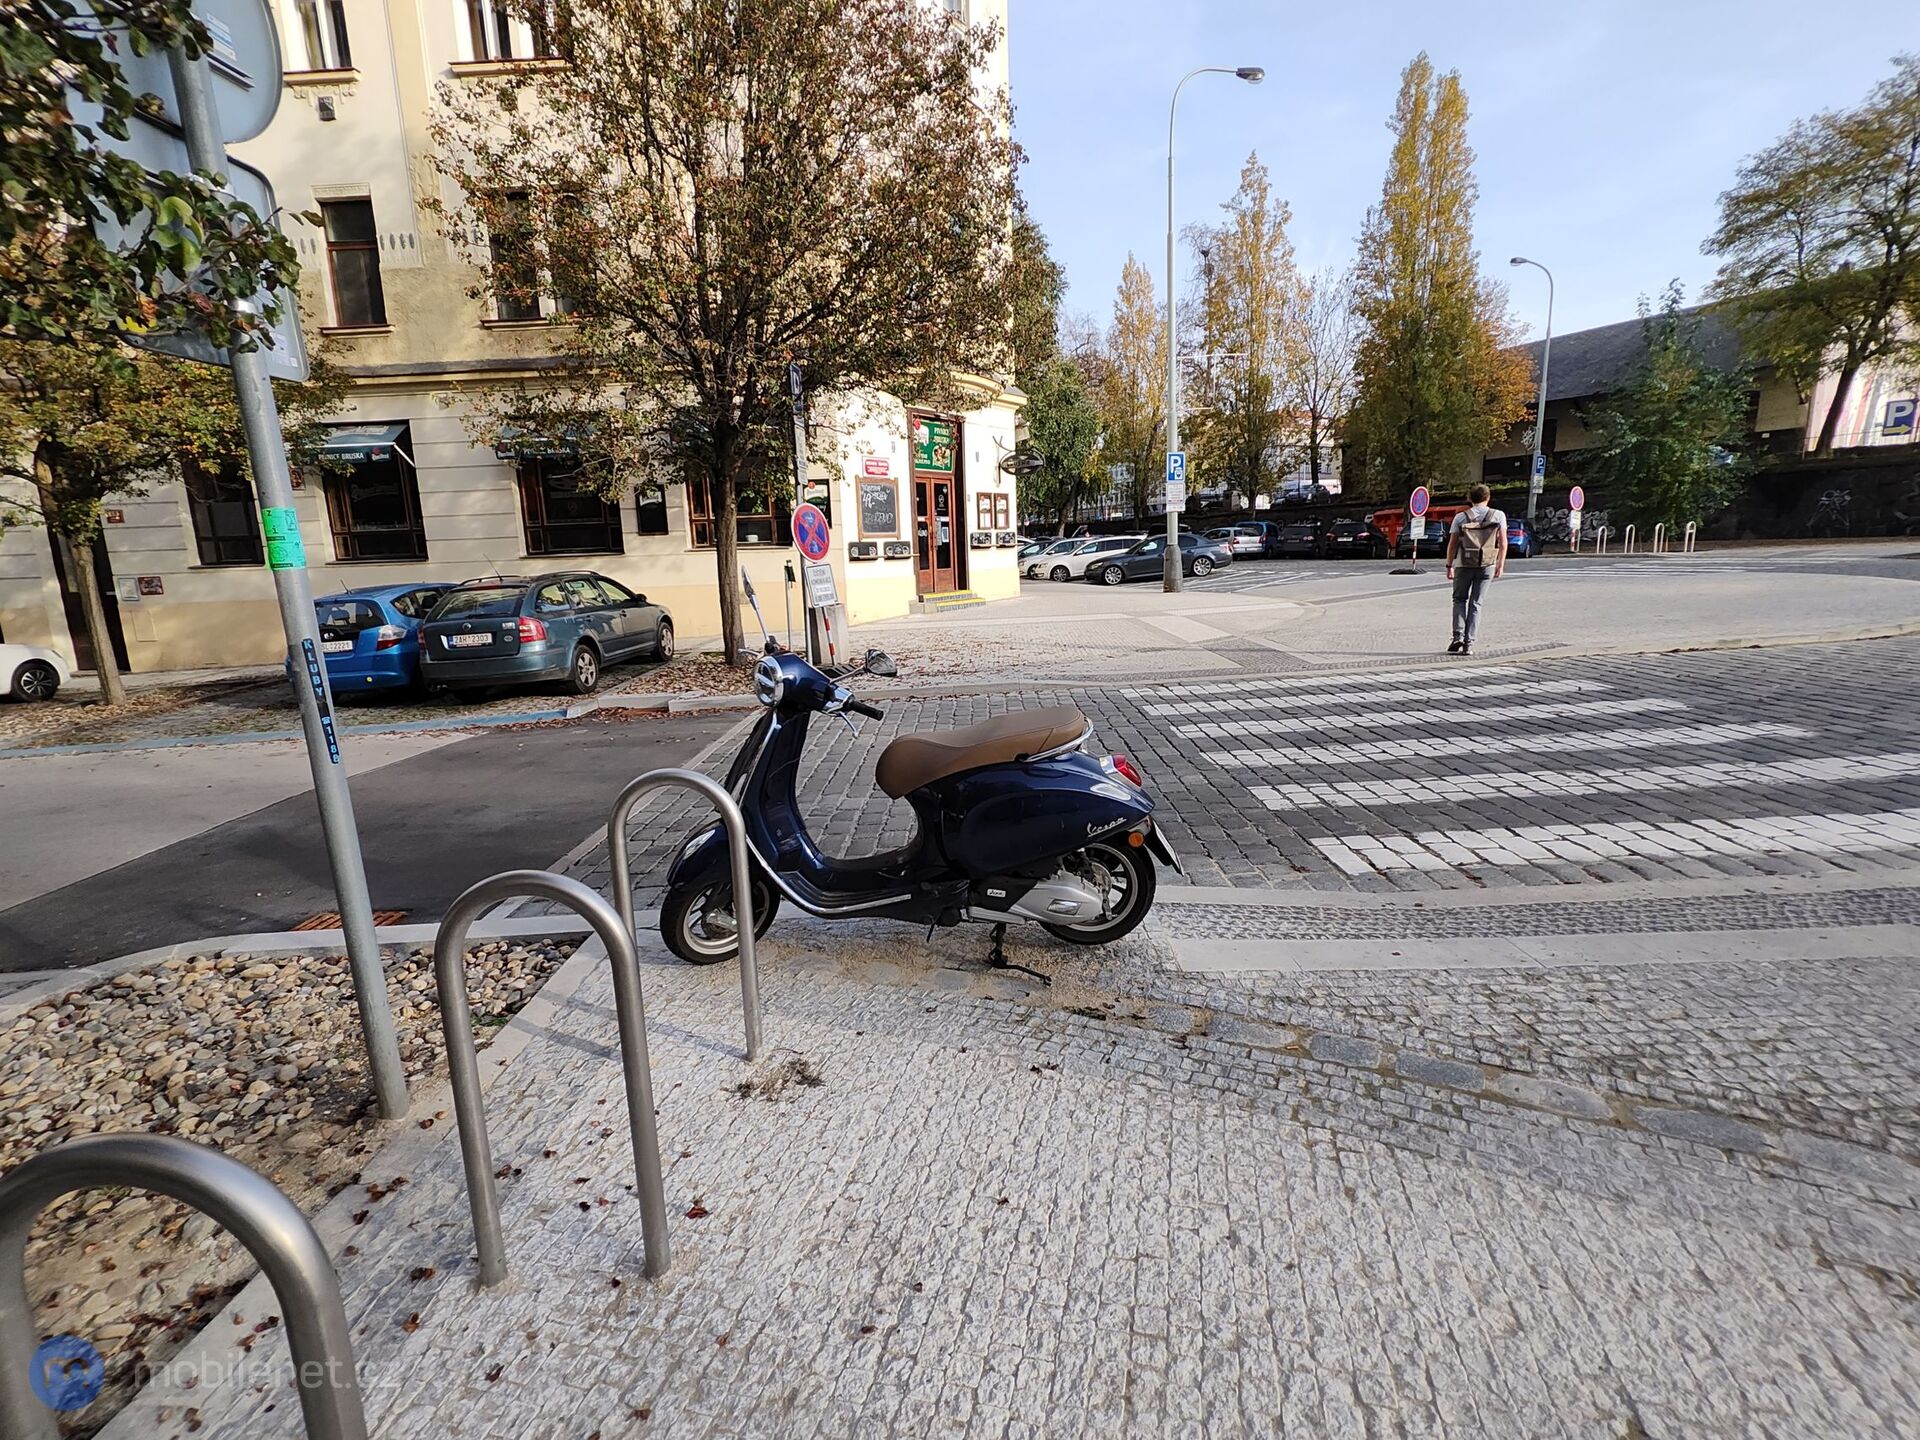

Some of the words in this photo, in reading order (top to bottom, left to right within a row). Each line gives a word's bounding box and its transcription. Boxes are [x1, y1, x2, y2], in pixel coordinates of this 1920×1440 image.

[1886, 401, 1914, 427] P
[1170, 456, 1181, 473] P
[1537, 457, 1544, 468] P
[303, 640, 323, 696] KLUBY
[326, 726, 340, 762] 1188
[1087, 817, 1127, 837] Vespa
